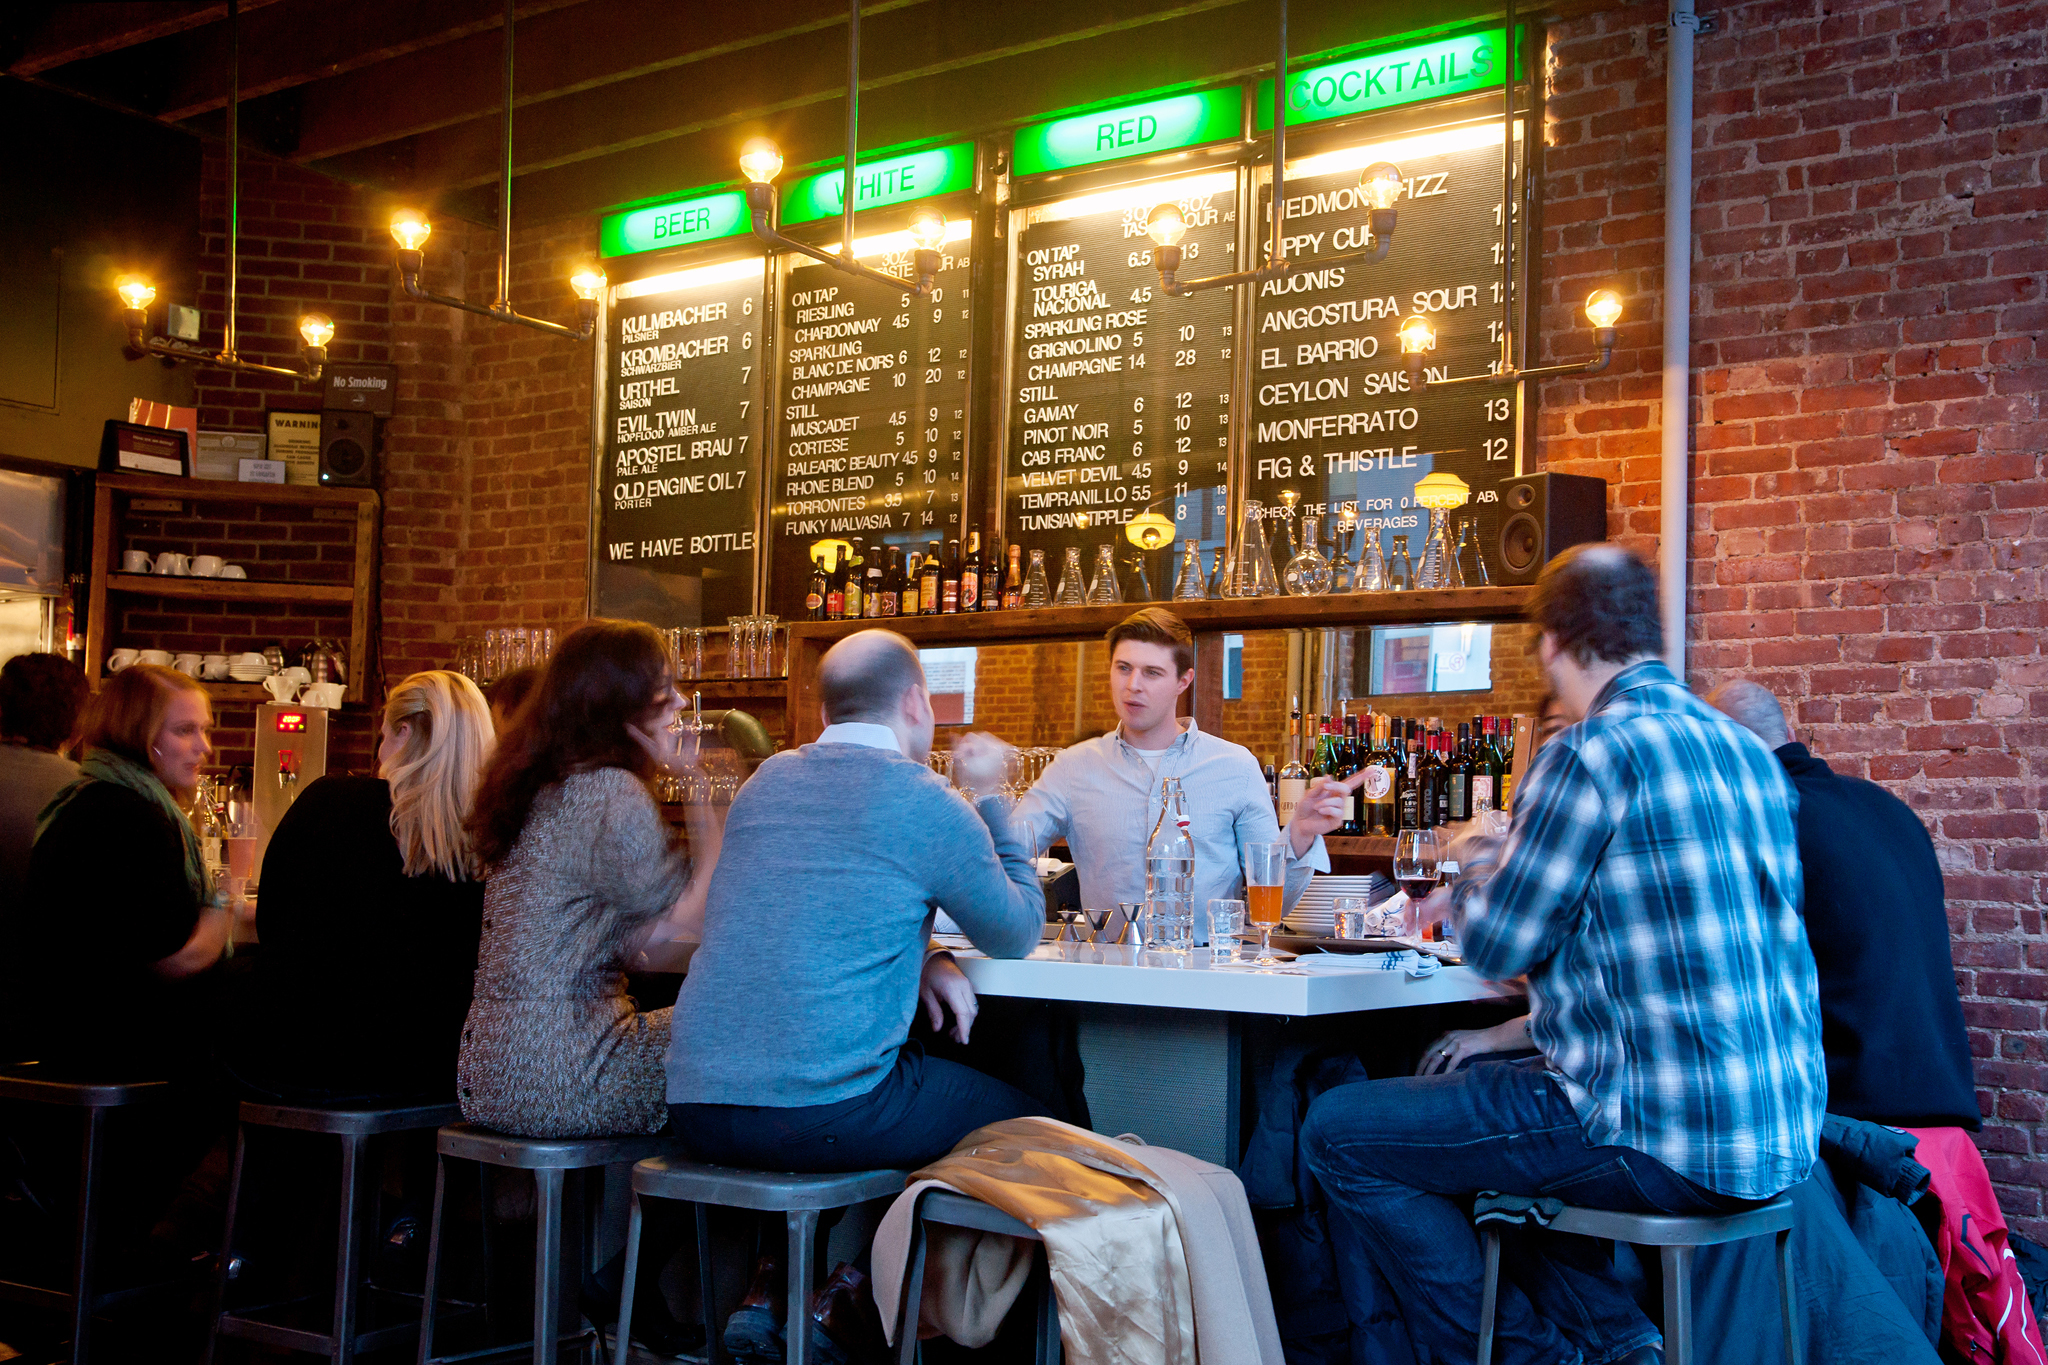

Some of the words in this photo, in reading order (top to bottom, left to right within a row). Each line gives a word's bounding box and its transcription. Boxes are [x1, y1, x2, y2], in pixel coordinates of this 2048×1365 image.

[1288, 45, 1494, 111] COCKTAILS
[1096, 115, 1158, 152] RED
[654, 207, 710, 239] BEER
[1027, 249, 1049, 266] ON
[1051, 244, 1080, 262] TAP
[1263, 232, 1325, 260] SPPY
[1033, 260, 1085, 282] SYRAH
[1128, 250, 1151, 268] 6.5
[1181, 243, 1199, 260] 13
[792, 292, 811, 307] ON
[813, 287, 838, 303] TAP
[1032, 280, 1097, 302] TOURIGA
[1260, 267, 1346, 297] ADONIS
[622, 302, 727, 336] KULMBACHER
[743, 297, 752, 315] 6
[797, 302, 854, 324] RIESLING
[901, 293, 910, 308] 5
[930, 288, 943, 303] 10
[1033, 293, 1110, 318] NACIONAL
[1130, 287, 1152, 303] 4.5
[1261, 296, 1400, 334] ANGOSTURA
[1412, 285, 1477, 314] SOUR
[622, 330, 659, 344] PILSNER
[795, 318, 882, 344] CHARDONNAY
[933, 308, 942, 323] 9
[1025, 315, 1102, 339] SPARKLING
[1105, 309, 1147, 330] ROSE
[621, 336, 729, 368] KROMBACHER
[742, 332, 752, 349] 6
[789, 340, 862, 364] SPARKLING
[1028, 334, 1122, 360] GRIGNOLINO
[1133, 331, 1143, 347] 5
[1178, 325, 1195, 342] 10
[1222, 326, 1232, 336] 13
[1260, 347, 1288, 370] EL
[1297, 335, 1378, 366] BARRIO
[621, 359, 681, 377] SCHWARZBIER
[793, 362, 834, 381] BLANC
[836, 360, 853, 375] DE
[856, 354, 894, 373] NOIRS
[899, 350, 908, 365] 6
[928, 347, 941, 363] 12
[959, 349, 968, 359] 12
[1028, 356, 1122, 381] CHAMPAGNE
[1128, 353, 1146, 369] 14
[1175, 349, 1196, 366] 28
[1221, 348, 1231, 359] 12
[334, 376, 346, 387] No
[348, 376, 387, 390] Smoking
[619, 377, 680, 401] URTHEL
[742, 366, 751, 384] 7
[791, 377, 870, 400] CHAMPAGNE
[893, 372, 906, 388] 10
[925, 368, 942, 384] 20
[957, 370, 966, 380] 12
[1019, 385, 1058, 403] STILL
[1258, 377, 1349, 407] CEYLON
[617, 414, 652, 434] EVIL
[655, 408, 696, 429] TWIN
[739, 401, 750, 419] 7
[619, 398, 651, 410] SAISON
[786, 404, 819, 420] STILL
[1024, 404, 1079, 424] GAMAY
[1134, 397, 1144, 413] 6
[1175, 392, 1192, 409] 12
[1219, 394, 1229, 404] 13
[275, 419, 319, 429] WARNIN
[618, 429, 664, 443] HOPFLOOD
[668, 424, 698, 437] AMBER
[700, 423, 716, 434] ALE
[790, 416, 860, 437] MUSCADET
[889, 411, 907, 426] 4.5
[929, 407, 938, 422] 9
[954, 409, 963, 419] 12
[1024, 426, 1068, 445] PINOT
[1072, 422, 1109, 441] NOIR
[1133, 419, 1143, 435] 5
[1174, 415, 1191, 431] 10
[1219, 414, 1229, 425] 13
[1258, 407, 1419, 444] MONFERRATO
[1483, 398, 1510, 422] 13
[616, 444, 685, 468] APOSTEL
[691, 438, 732, 460] BRAU
[738, 436, 748, 453] 7
[789, 438, 849, 457] CORTESE
[896, 431, 905, 446] 5
[925, 427, 938, 443] 10
[953, 430, 962, 440] 12
[1021, 450, 1050, 467] CAB
[1054, 444, 1106, 464] FRANC
[1132, 441, 1143, 457] 6
[1175, 437, 1191, 453] 12
[1218, 437, 1227, 448] 13
[617, 465, 638, 476] PALE
[641, 464, 658, 474] ALE
[787, 457, 847, 477] BALEARIC
[849, 452, 899, 471] BEAUTY
[929, 448, 937, 463] 9
[952, 451, 961, 461] 12
[1258, 456, 1292, 480] FIG
[1299, 454, 1316, 477] &
[1323, 445, 1418, 475] THISTLE
[1482, 437, 1509, 462] 12
[614, 481, 645, 500] OLD
[647, 475, 704, 498] ENGINE
[708, 472, 734, 492] OIL
[736, 471, 746, 488] 7
[786, 480, 830, 497] RHONE
[832, 475, 874, 493] BLEND
[895, 472, 904, 487] 5
[923, 469, 936, 484] 10
[1022, 469, 1076, 488] VELVET
[1080, 465, 1122, 484] DEVIL
[1178, 460, 1189, 475] 9
[1217, 462, 1227, 473] 14
[615, 498, 652, 510] PORTER
[786, 496, 866, 516] TORRONTES
[926, 489, 935, 504] 7
[1174, 482, 1188, 498] 11
[1216, 485, 1227, 495] 13
[1304, 503, 1326, 516] THE
[1333, 501, 1360, 514] LIST
[1366, 498, 1393, 512] FOR
[1413, 492, 1471, 508] PERCENT
[786, 519, 828, 536] FUNKY
[831, 514, 892, 534] MALVASIA
[902, 512, 911, 527] 7
[920, 510, 934, 526] 14
[949, 513, 958, 523] 12
[1019, 513, 1081, 532] TUNISIAN
[1086, 508, 1134, 527] TIPPLE
[1177, 504, 1187, 520] 8
[1216, 505, 1226, 515] 12
[1337, 515, 1419, 533] BEVERAGES
[609, 542, 633, 561] WE
[641, 538, 683, 558] HAVE
[690, 532, 756, 554] BOTTLE
